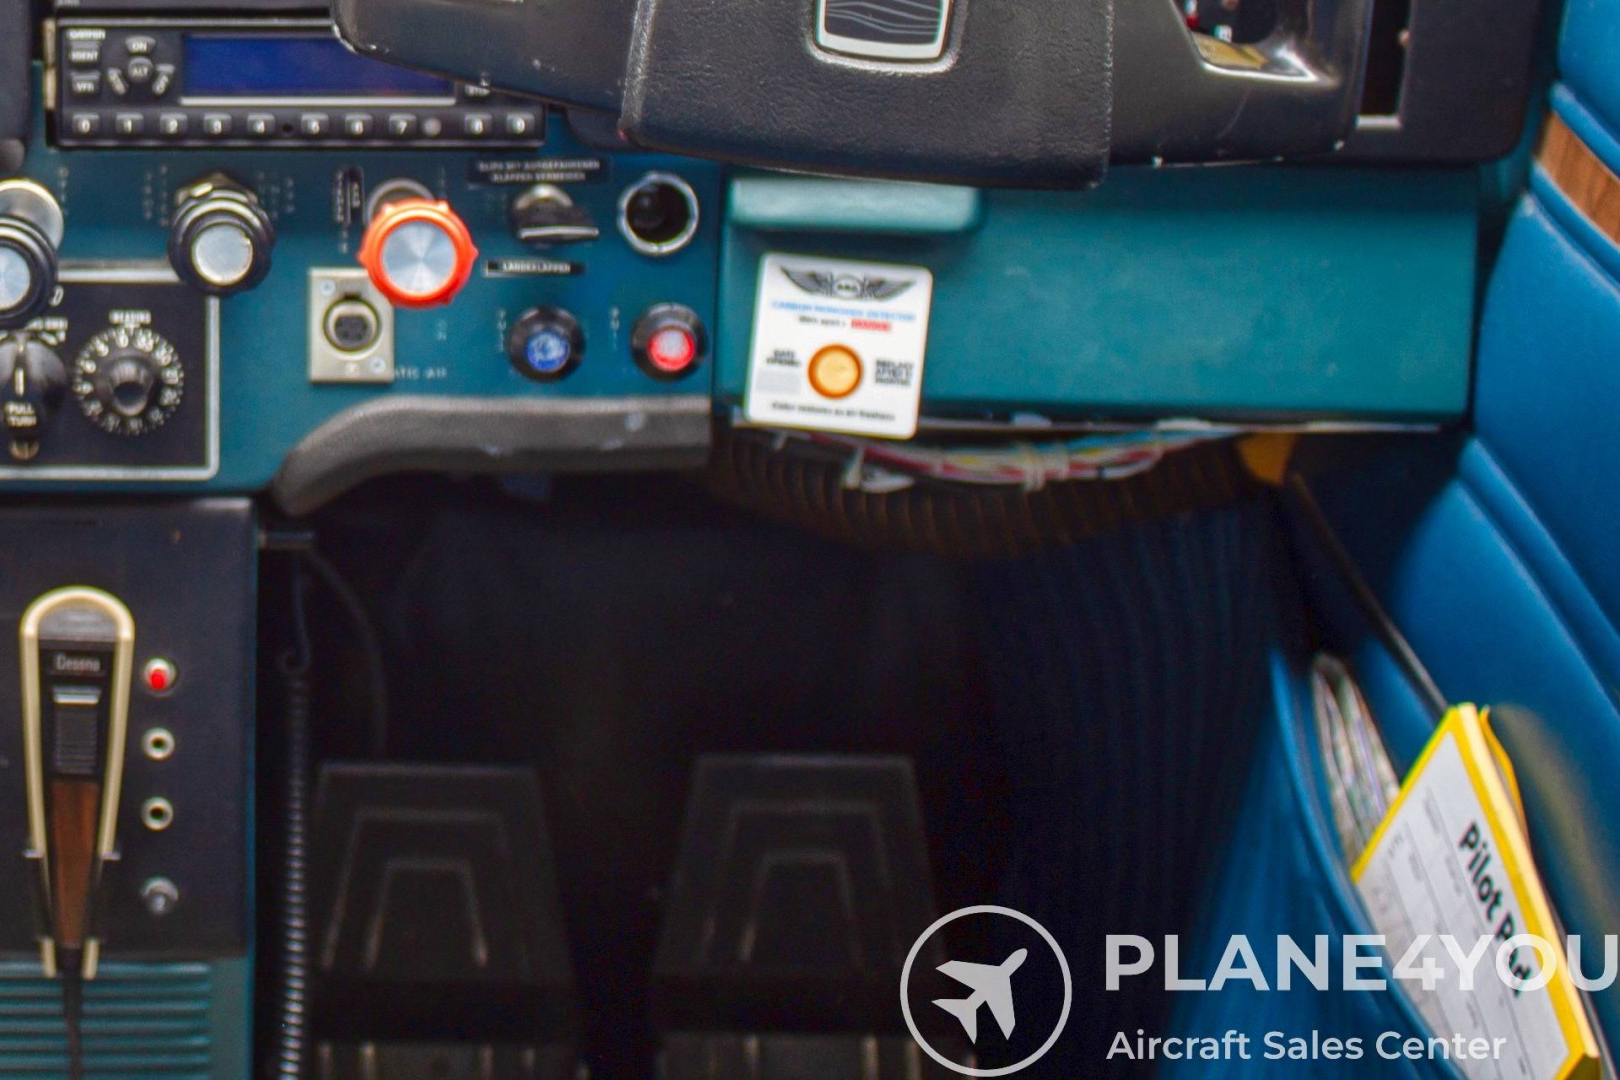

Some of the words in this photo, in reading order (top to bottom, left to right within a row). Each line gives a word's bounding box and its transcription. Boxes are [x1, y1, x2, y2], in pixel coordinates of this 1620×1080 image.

[67, 29, 106, 40] GARMIN
[132, 42, 148, 52] ON
[70, 51, 98, 62] IDENT
[74, 82, 95, 93] VFR
[81, 118, 91, 133] 0
[123, 118, 132, 132] 1
[169, 118, 178, 134] 2
[213, 118, 222, 134] 3
[397, 119, 408, 135] 7
[1458, 820, 1503, 921] Pilot
